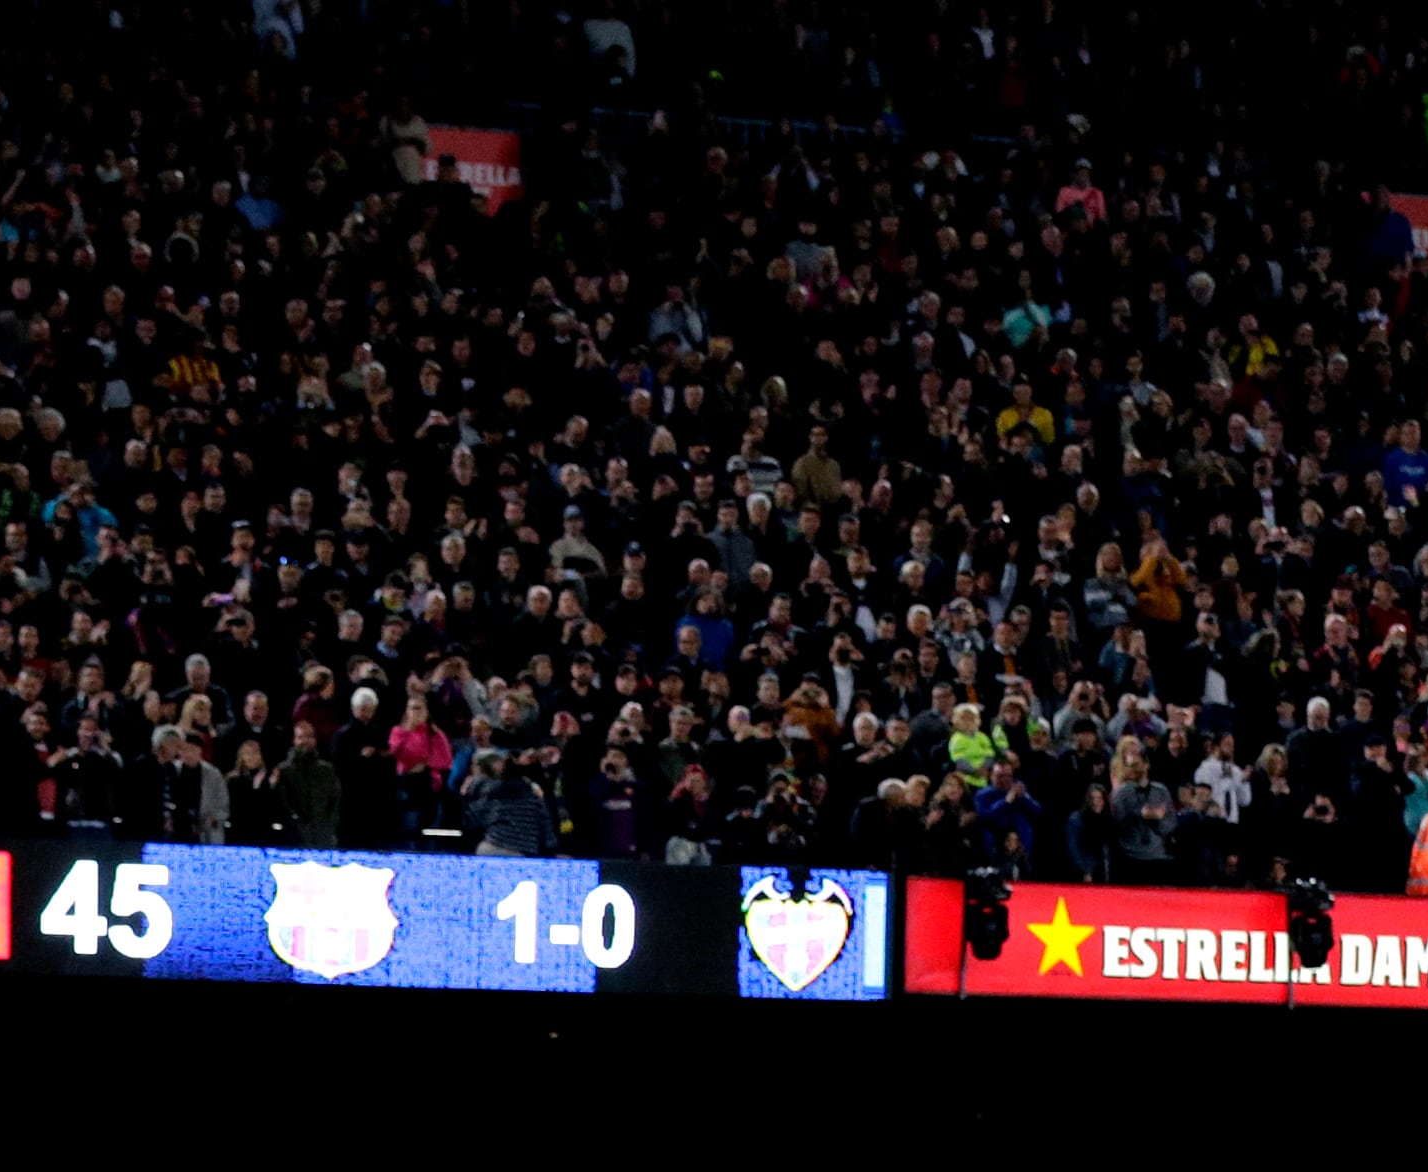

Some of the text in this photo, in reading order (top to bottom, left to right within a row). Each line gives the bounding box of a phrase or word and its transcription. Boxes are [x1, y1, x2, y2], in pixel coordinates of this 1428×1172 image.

[40, 859, 173, 960] 45
[496, 880, 636, 969] 1-0
[1102, 925, 1332, 984] ESTRELL
